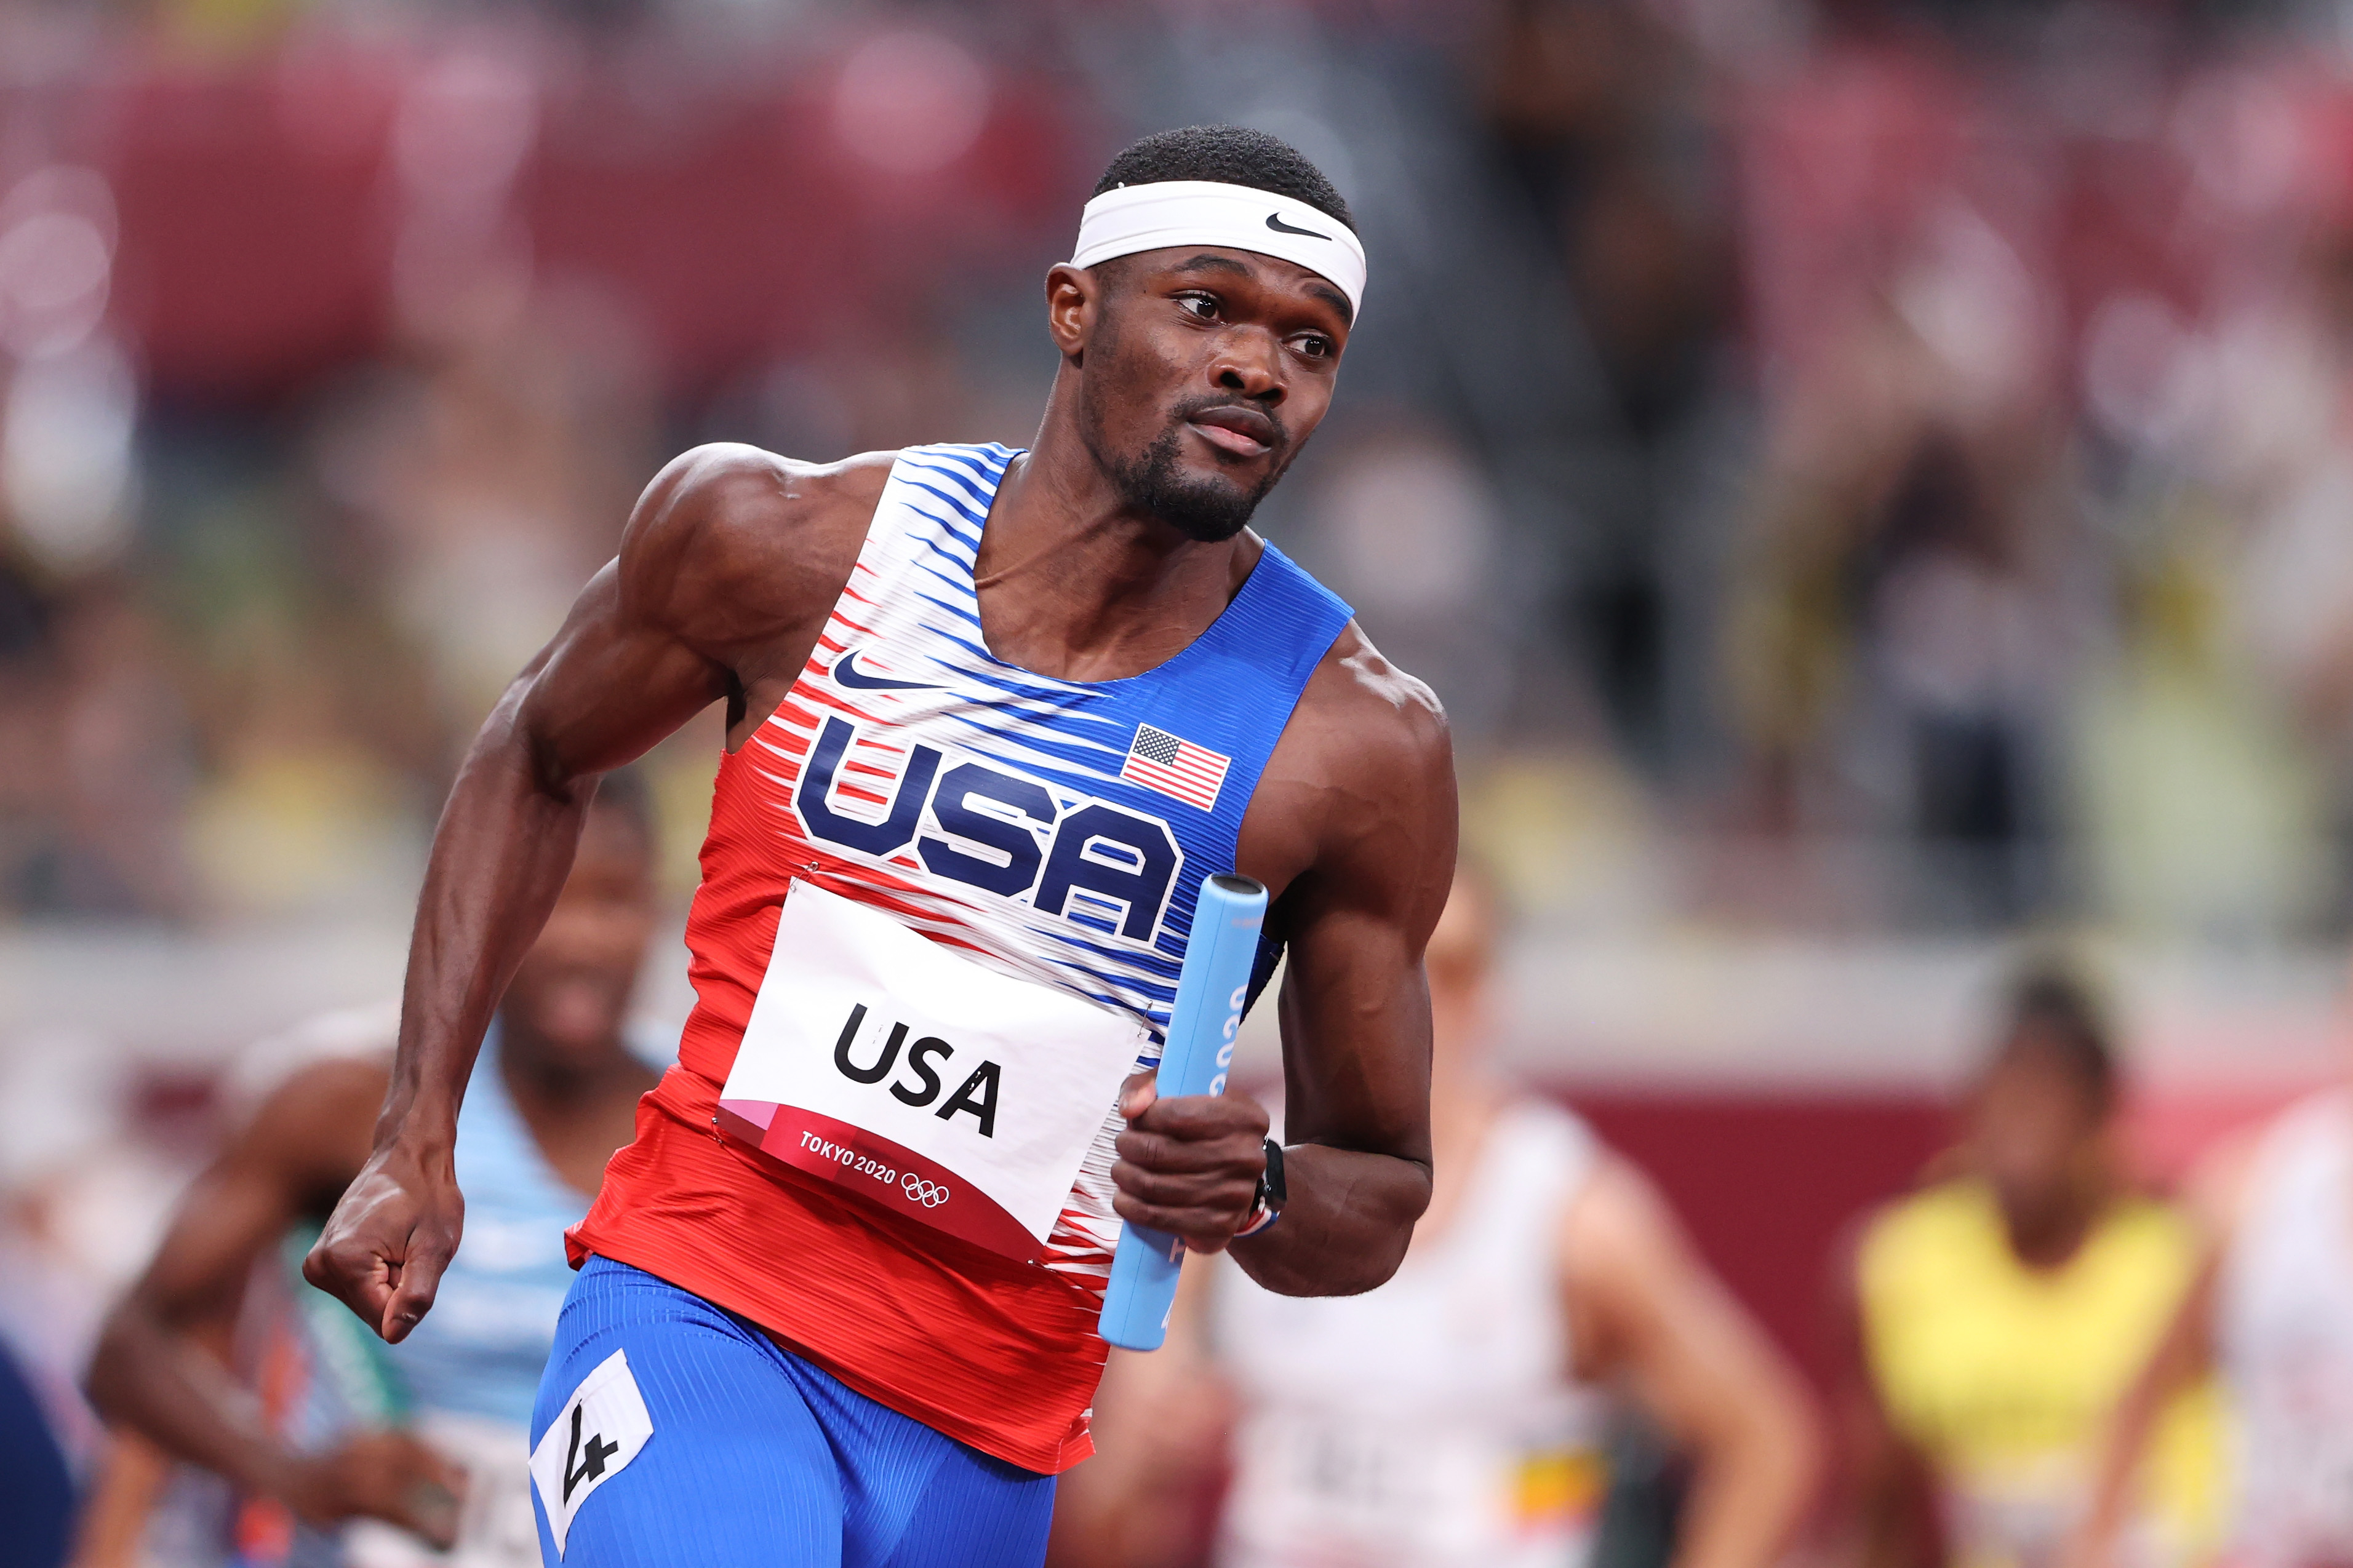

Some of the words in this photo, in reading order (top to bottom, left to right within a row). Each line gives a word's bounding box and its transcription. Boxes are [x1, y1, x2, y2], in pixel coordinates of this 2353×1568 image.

[795, 713, 1180, 944] USA
[834, 1002, 1001, 1139] USA
[800, 1131, 855, 1166] TOKYO
[853, 1156, 896, 1184] 2020
[563, 1398, 618, 1509] 4
